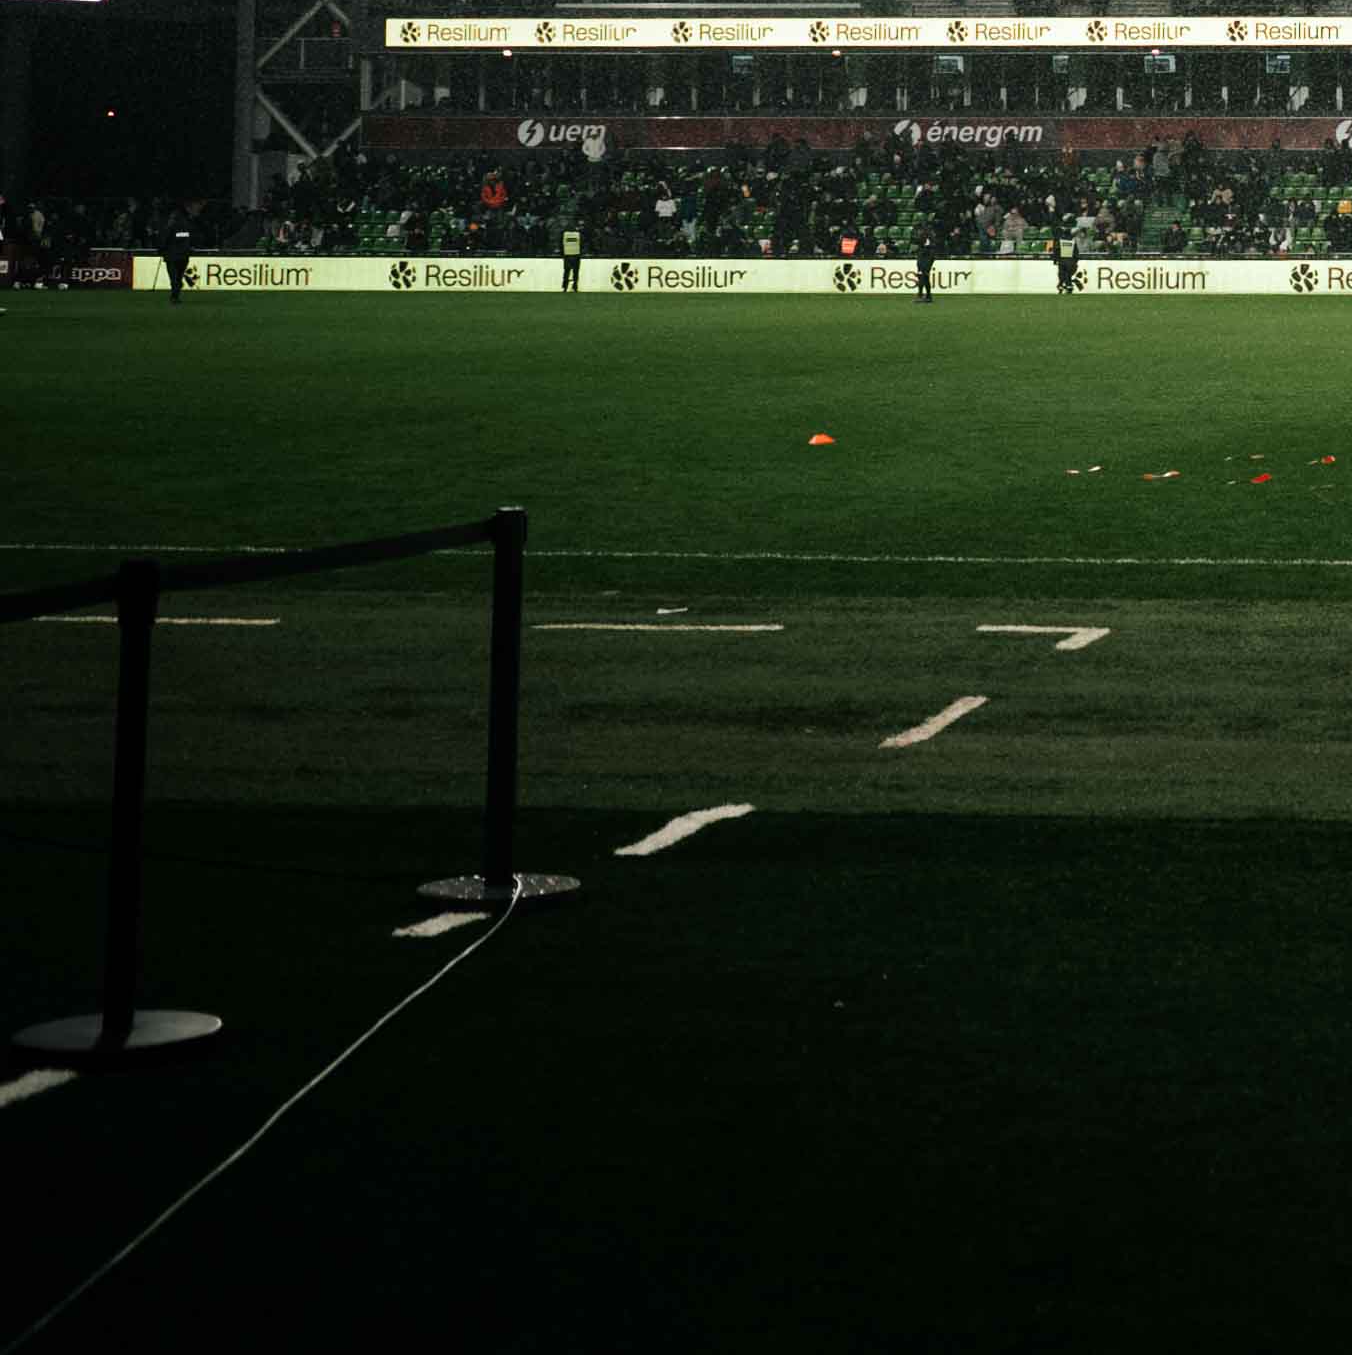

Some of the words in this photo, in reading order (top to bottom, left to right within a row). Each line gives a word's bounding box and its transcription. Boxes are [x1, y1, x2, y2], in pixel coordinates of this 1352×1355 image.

[427, 23, 508, 42] Resilium
[834, 22, 920, 41] Resilium
[1254, 21, 1341, 40] Resilium
[71, 267, 122, 282] appa
[206, 263, 310, 286] Resilium
[870, 266, 972, 290] Resiu
[1097, 267, 1206, 290] Resilium
